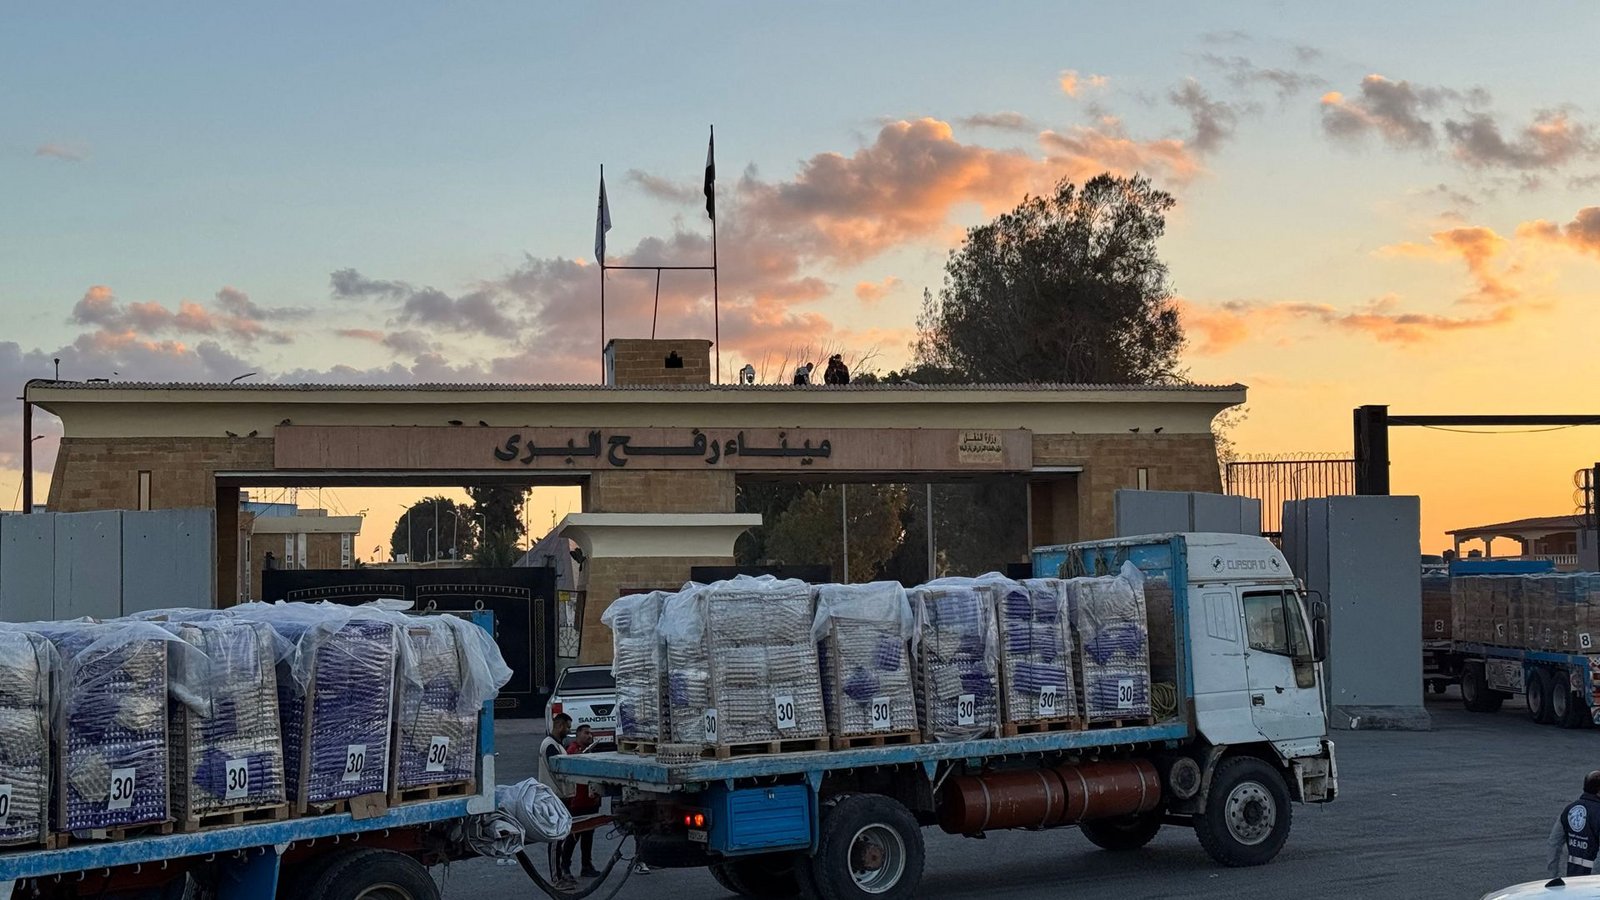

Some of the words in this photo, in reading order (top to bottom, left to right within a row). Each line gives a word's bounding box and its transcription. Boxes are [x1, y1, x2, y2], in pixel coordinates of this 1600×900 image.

[607, 427, 721, 467] رفح
[723, 430, 832, 465] ميناء
[1227, 560, 1257, 570] CURSOR
[1258, 560, 1266, 570] 10
[1436, 621, 1443, 631] 8
[1581, 635, 1590, 647] 8
[1040, 691, 1055, 708] 30
[1119, 685, 1133, 703] 30
[777, 702, 794, 722] 30
[873, 703, 888, 722] 30
[959, 700, 974, 719] 30
[705, 714, 717, 734] 30
[346, 752, 364, 774] 30
[429, 743, 447, 765] 30
[112, 776, 133, 801] 30
[228, 767, 247, 791] 30
